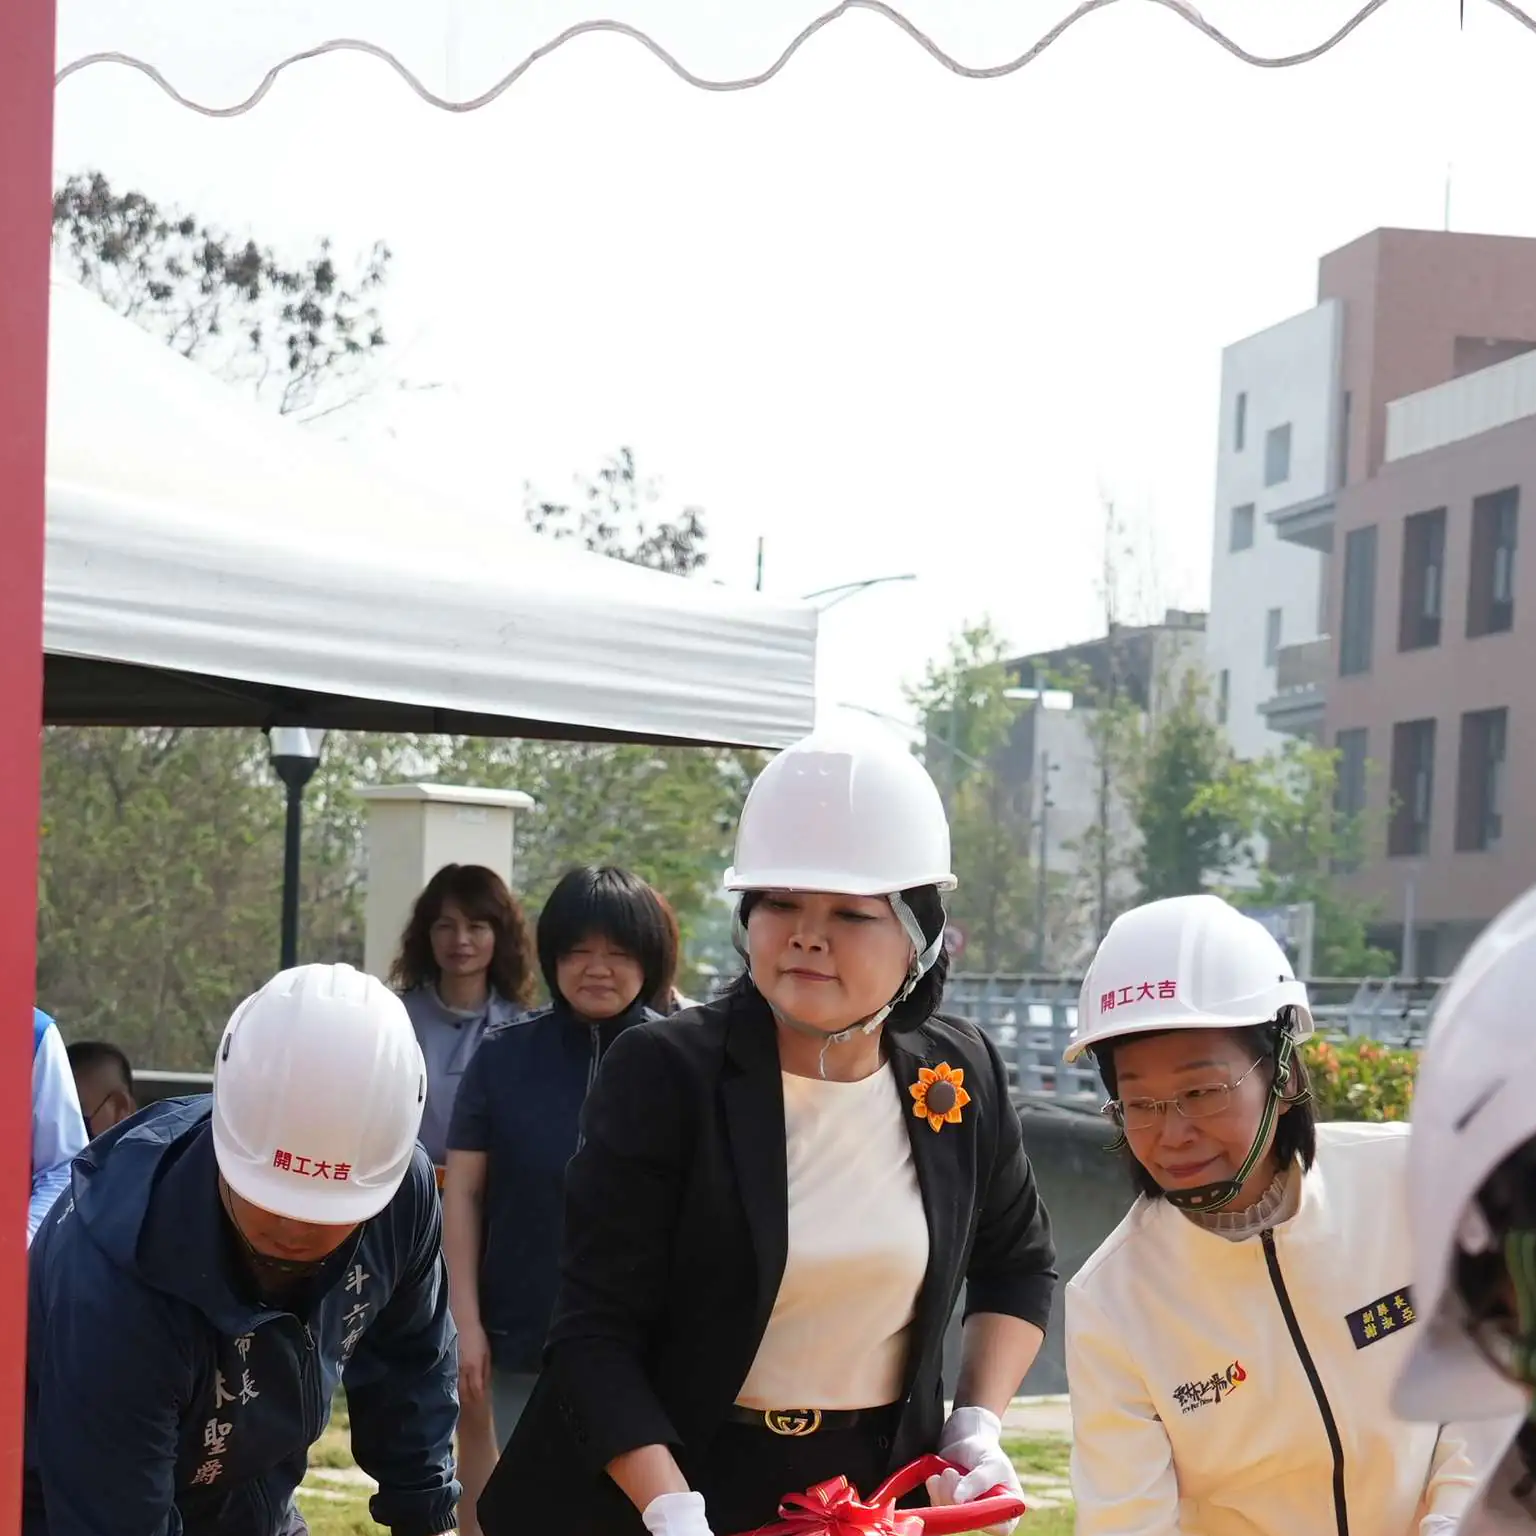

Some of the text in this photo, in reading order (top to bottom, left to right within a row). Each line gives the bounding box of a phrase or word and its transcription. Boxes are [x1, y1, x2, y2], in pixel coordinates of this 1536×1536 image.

[1101, 980, 1176, 1014] 開工大吉
[273, 1149, 351, 1180] 開工大吉
